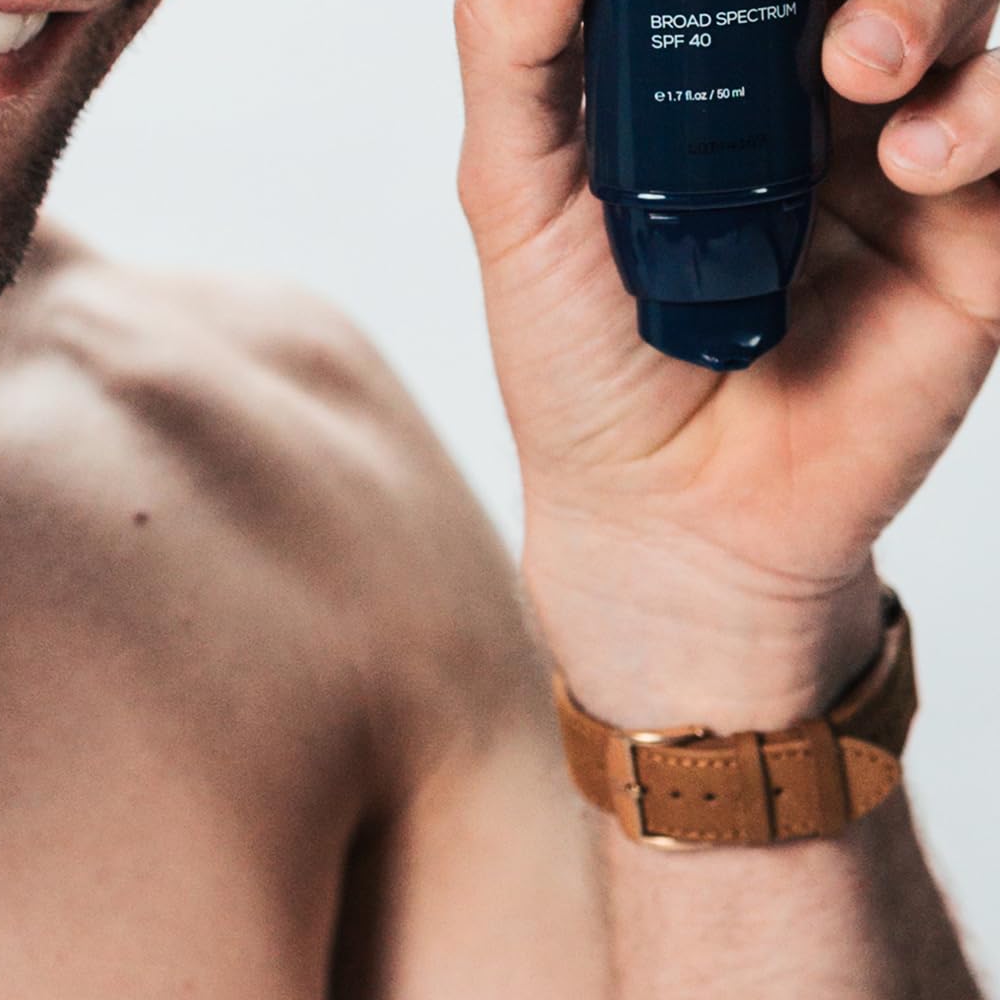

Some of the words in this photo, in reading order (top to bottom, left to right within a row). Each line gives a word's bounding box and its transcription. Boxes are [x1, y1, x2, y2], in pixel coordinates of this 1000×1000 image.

[650, 13, 712, 29] BROAD
[716, 1, 797, 26] SPECTRUM
[651, 34, 685, 49] SPF
[689, 32, 712, 47] 40
[716, 88, 730, 99] 50
[731, 86, 745, 98] ml
